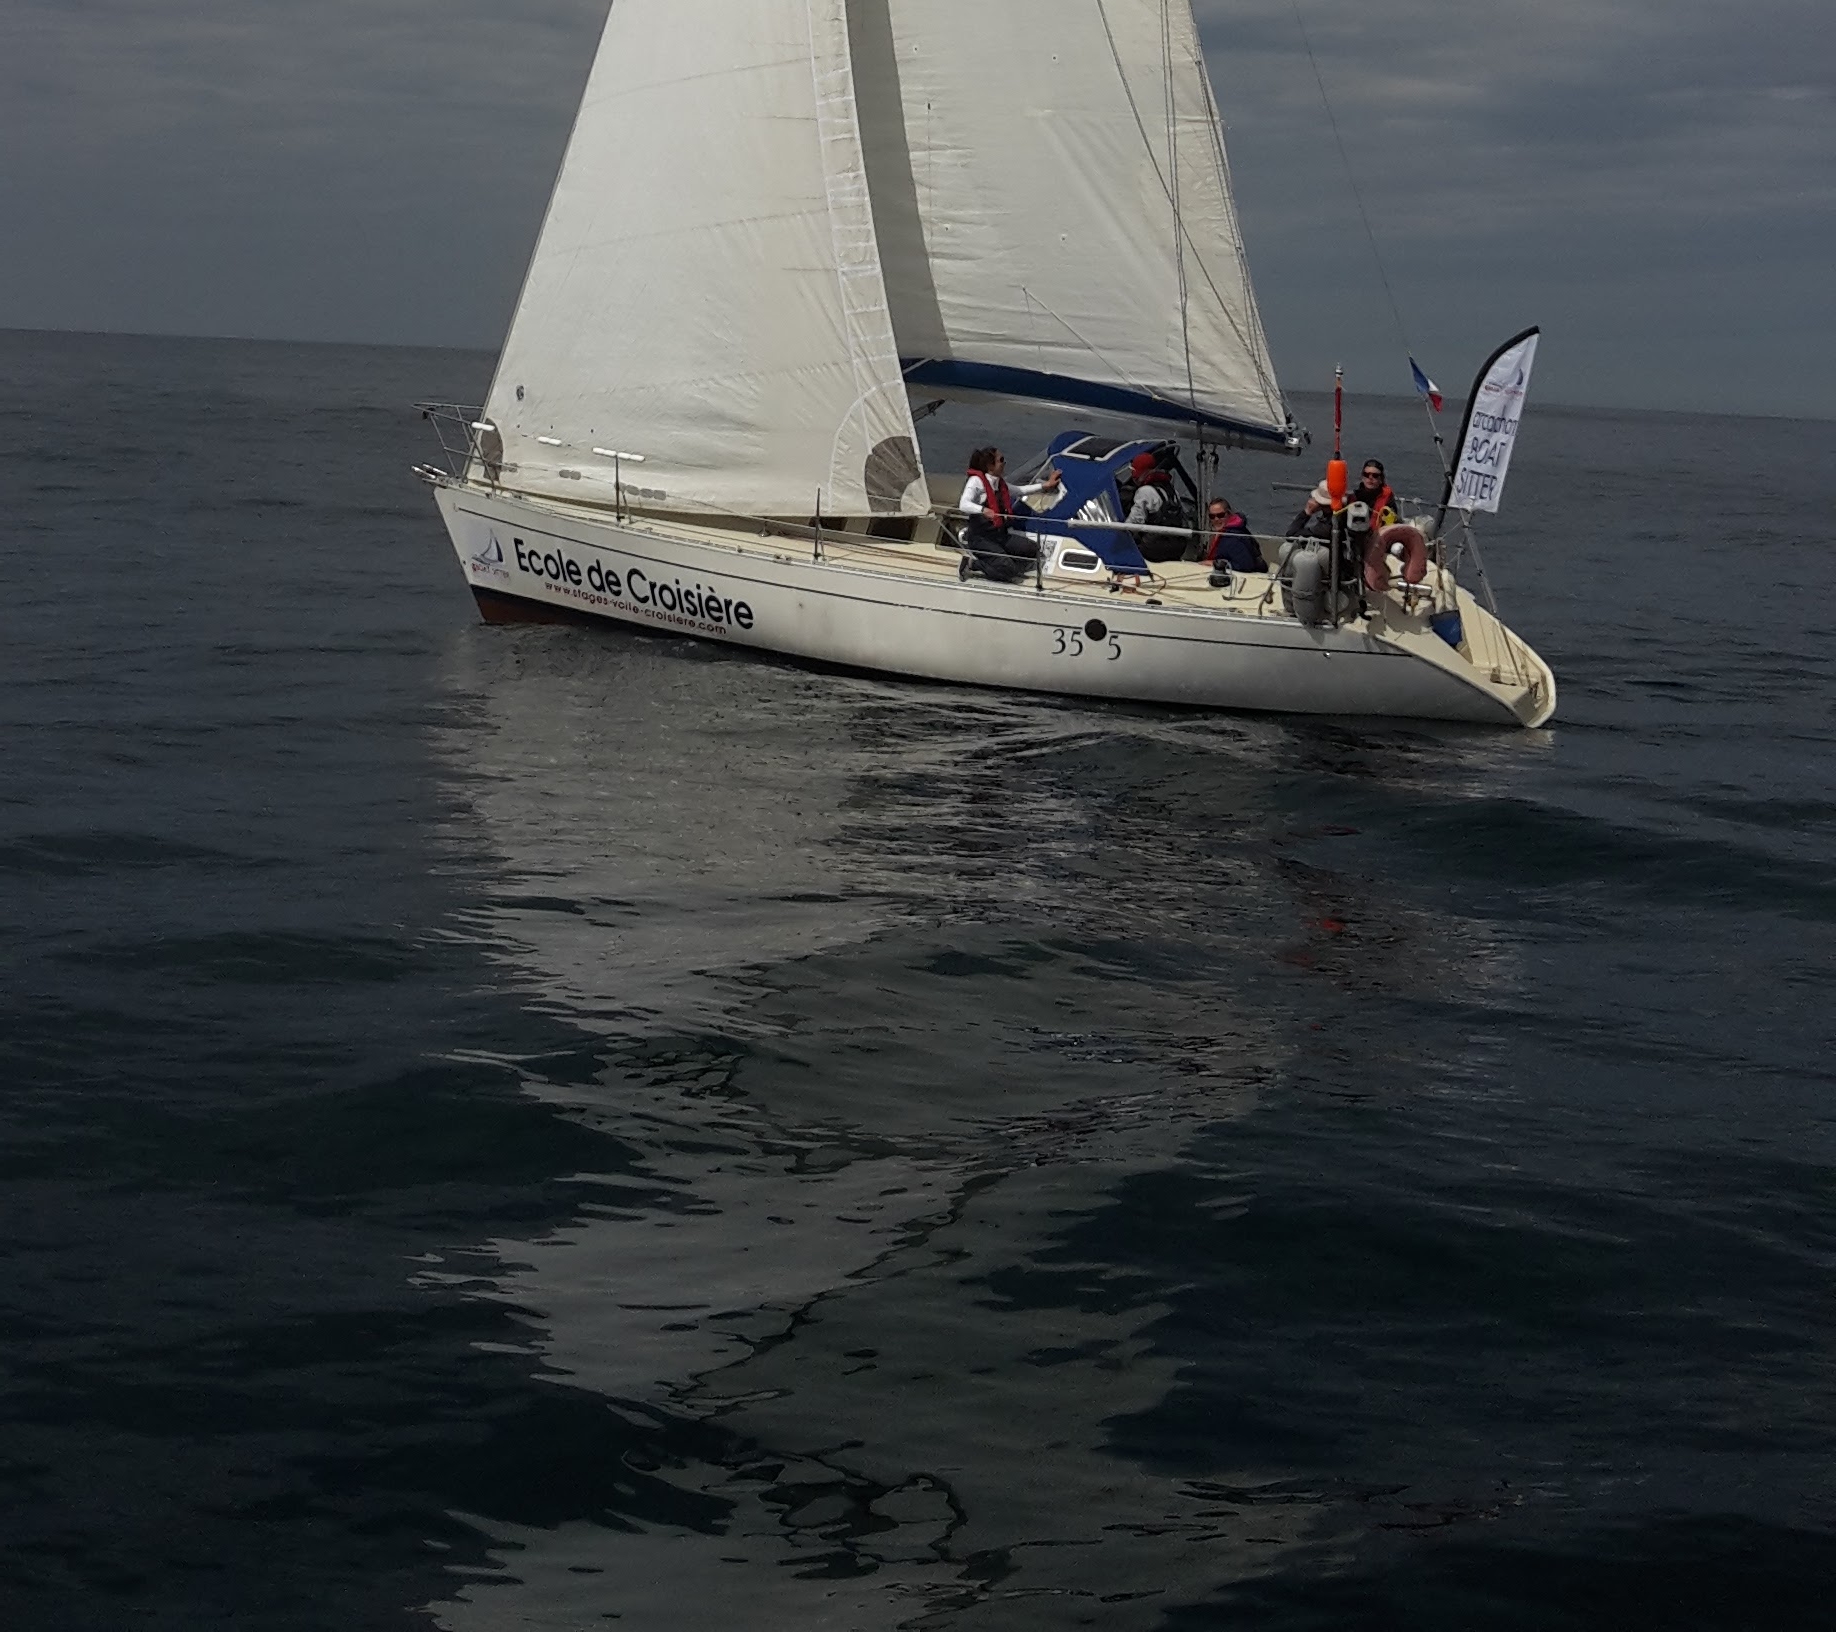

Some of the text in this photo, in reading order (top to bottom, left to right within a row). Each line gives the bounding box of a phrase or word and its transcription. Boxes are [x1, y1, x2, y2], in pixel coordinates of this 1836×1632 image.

[1467, 436, 1506, 467] BOAT
[1457, 467, 1497, 500] SITTER
[513, 537, 754, 629] Ecole de Croisière
